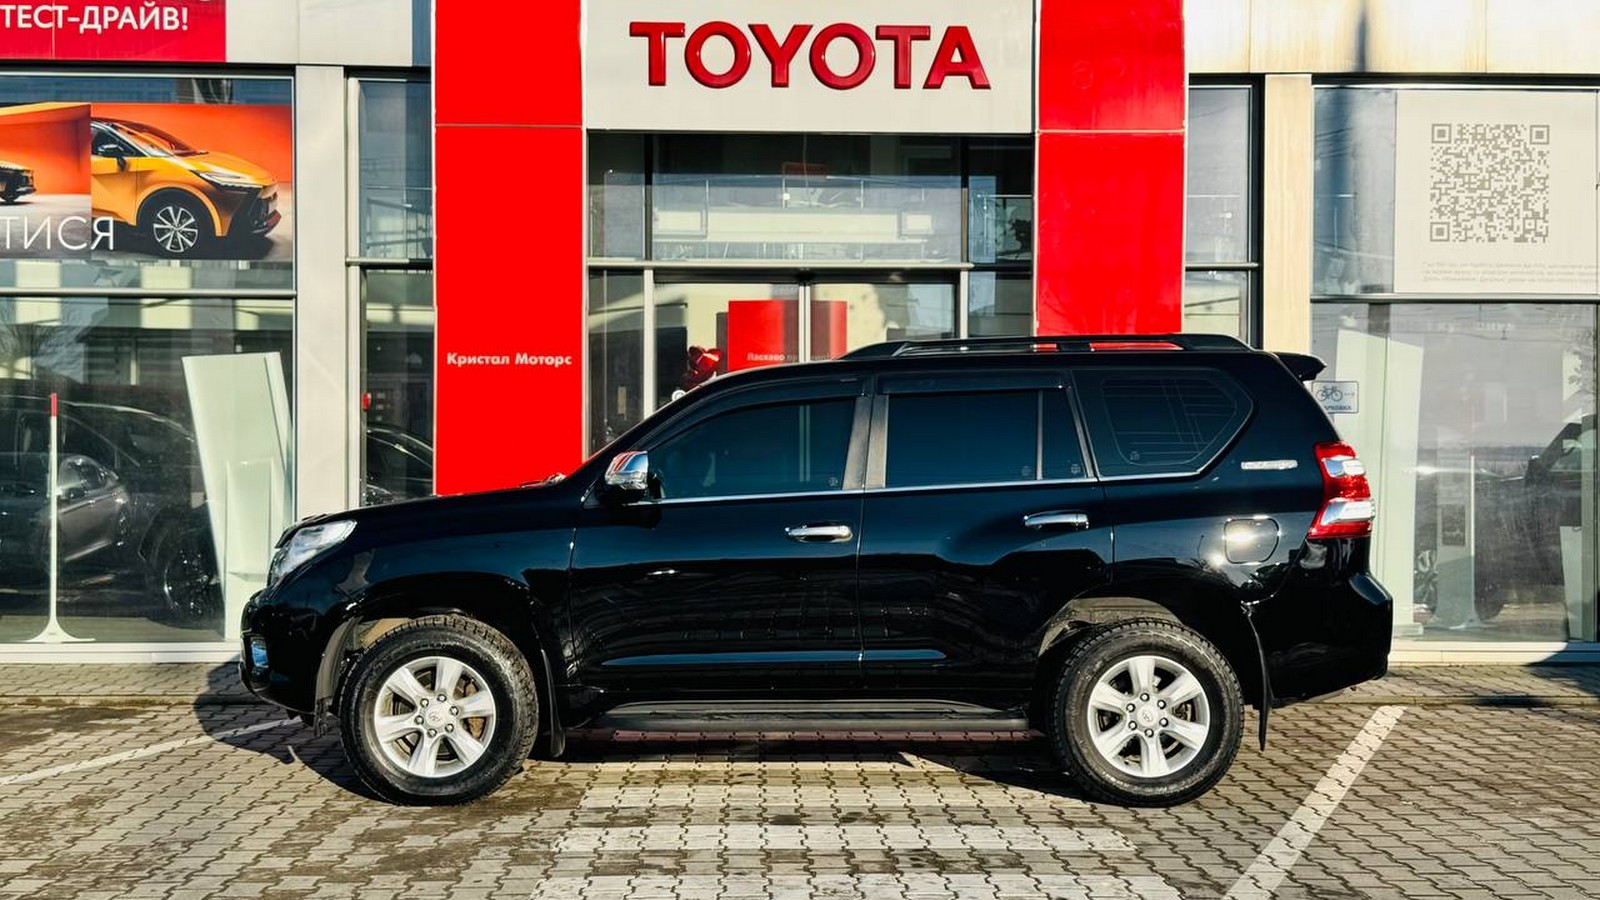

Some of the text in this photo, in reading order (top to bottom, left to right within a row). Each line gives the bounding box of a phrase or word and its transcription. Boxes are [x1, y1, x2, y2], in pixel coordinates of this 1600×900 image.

[0, 2, 188, 34] ТЕСТ-ДРАЙВ!
[629, 21, 991, 91] TOYOTA
[447, 353, 572, 367] Кристал Моторс
